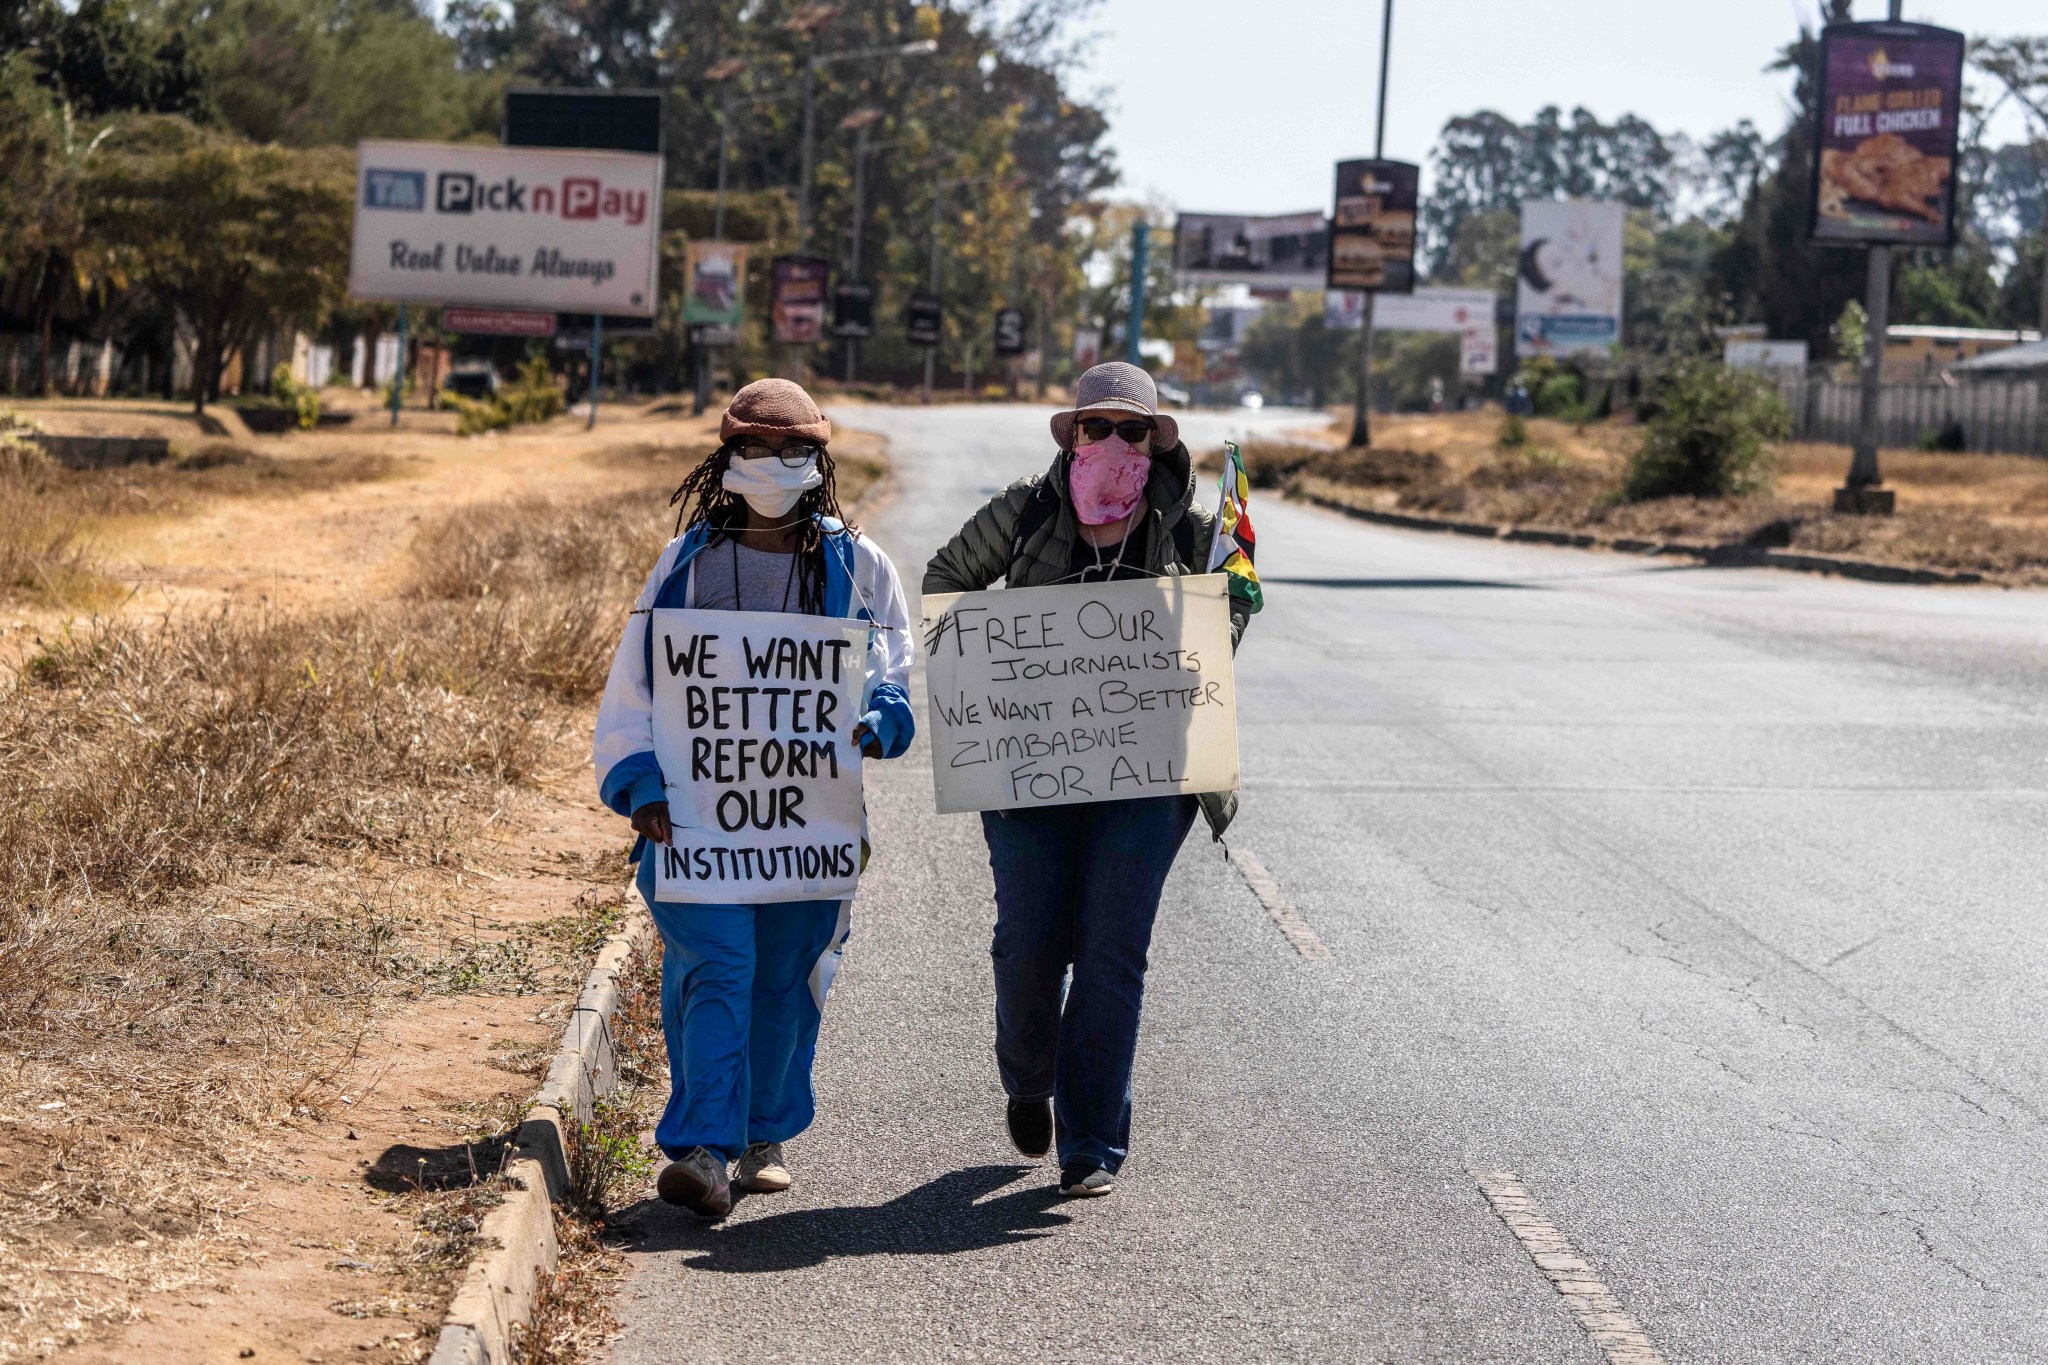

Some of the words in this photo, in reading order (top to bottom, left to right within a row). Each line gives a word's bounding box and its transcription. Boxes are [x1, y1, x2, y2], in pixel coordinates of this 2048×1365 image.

[1834, 115, 1871, 136] FULL
[1876, 110, 1941, 131] CHICKEN
[437, 173, 525, 214] Pick
[561, 177, 648, 226] Pay
[390, 240, 443, 271] Real
[456, 245, 522, 275] Value
[531, 248, 614, 284] Always
[924, 607, 1064, 657] #FREE
[1077, 600, 1163, 642] OUR
[664, 635, 719, 679] WE
[743, 636, 851, 684] WANT
[991, 650, 1201, 682] JOURNALISTS
[686, 685, 838, 733] BETTER
[934, 690, 982, 728] WE
[987, 695, 1053, 722] WANT
[1072, 696, 1094, 718] A
[1099, 680, 1224, 714] BETTER
[692, 736, 838, 783] REFORM
[950, 721, 1138, 768] ZIMBABWE
[1010, 761, 1092, 801] FOR
[1110, 756, 1189, 792] ALL
[716, 785, 806, 833] OUR
[664, 843, 855, 880] INSTITUTIONS
